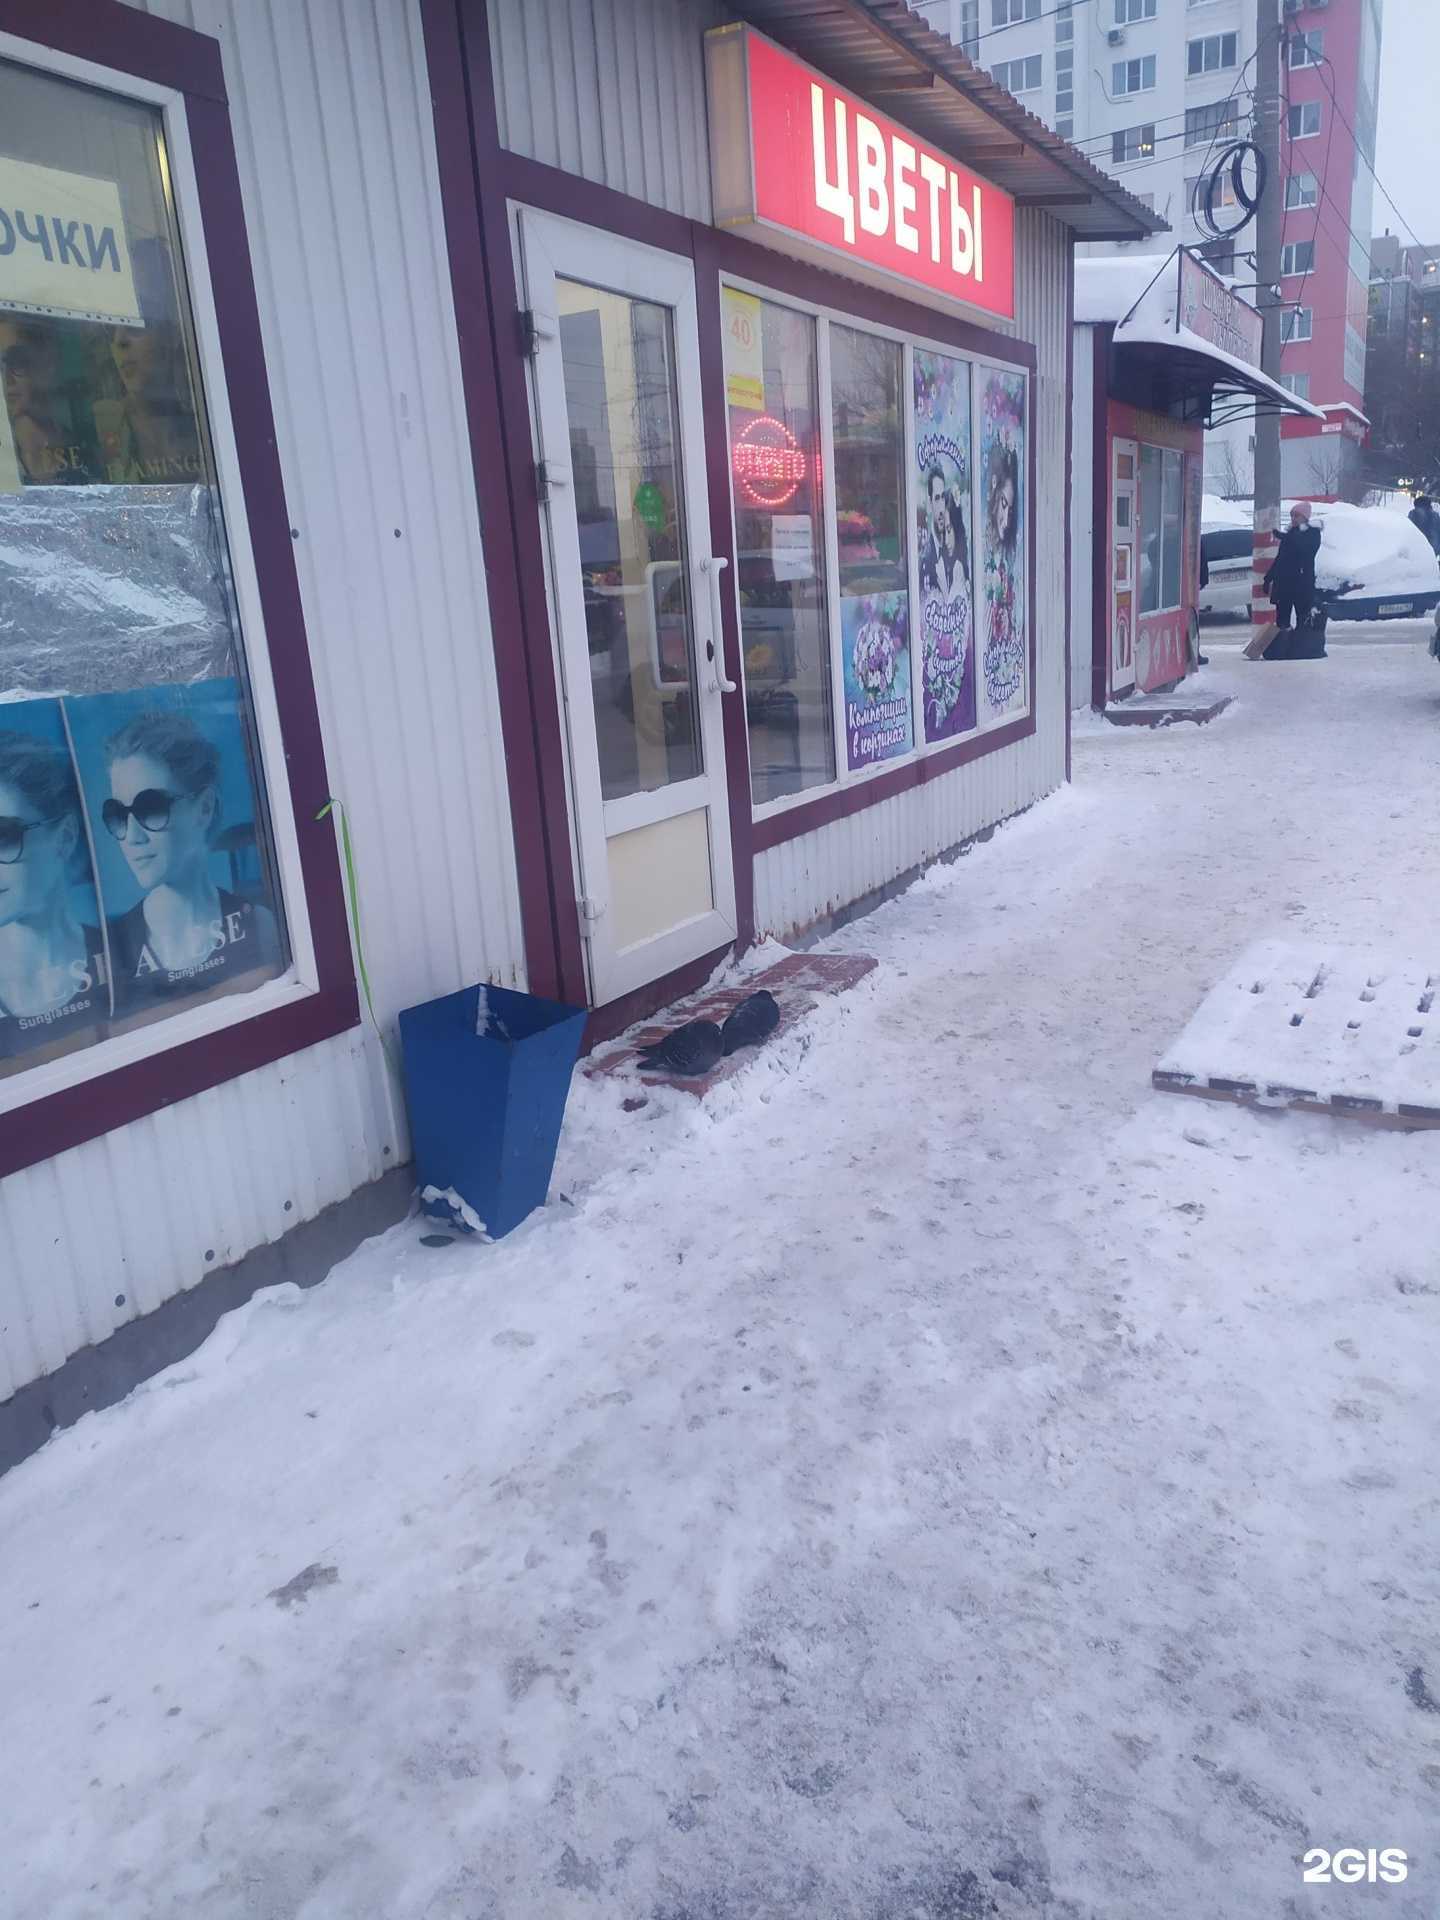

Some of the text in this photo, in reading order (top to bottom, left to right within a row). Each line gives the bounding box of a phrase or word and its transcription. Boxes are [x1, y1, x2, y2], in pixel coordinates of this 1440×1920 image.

[810, 82, 983, 282] ЦВЕТЫ
[735, 442, 806, 480] ОТКРЫТО
[849, 697, 908, 730] Композиции
[861, 725, 906, 760] корзинах
[167, 955, 225, 983] Sunglasses
[18, 1000, 91, 1031] Sunglasses
